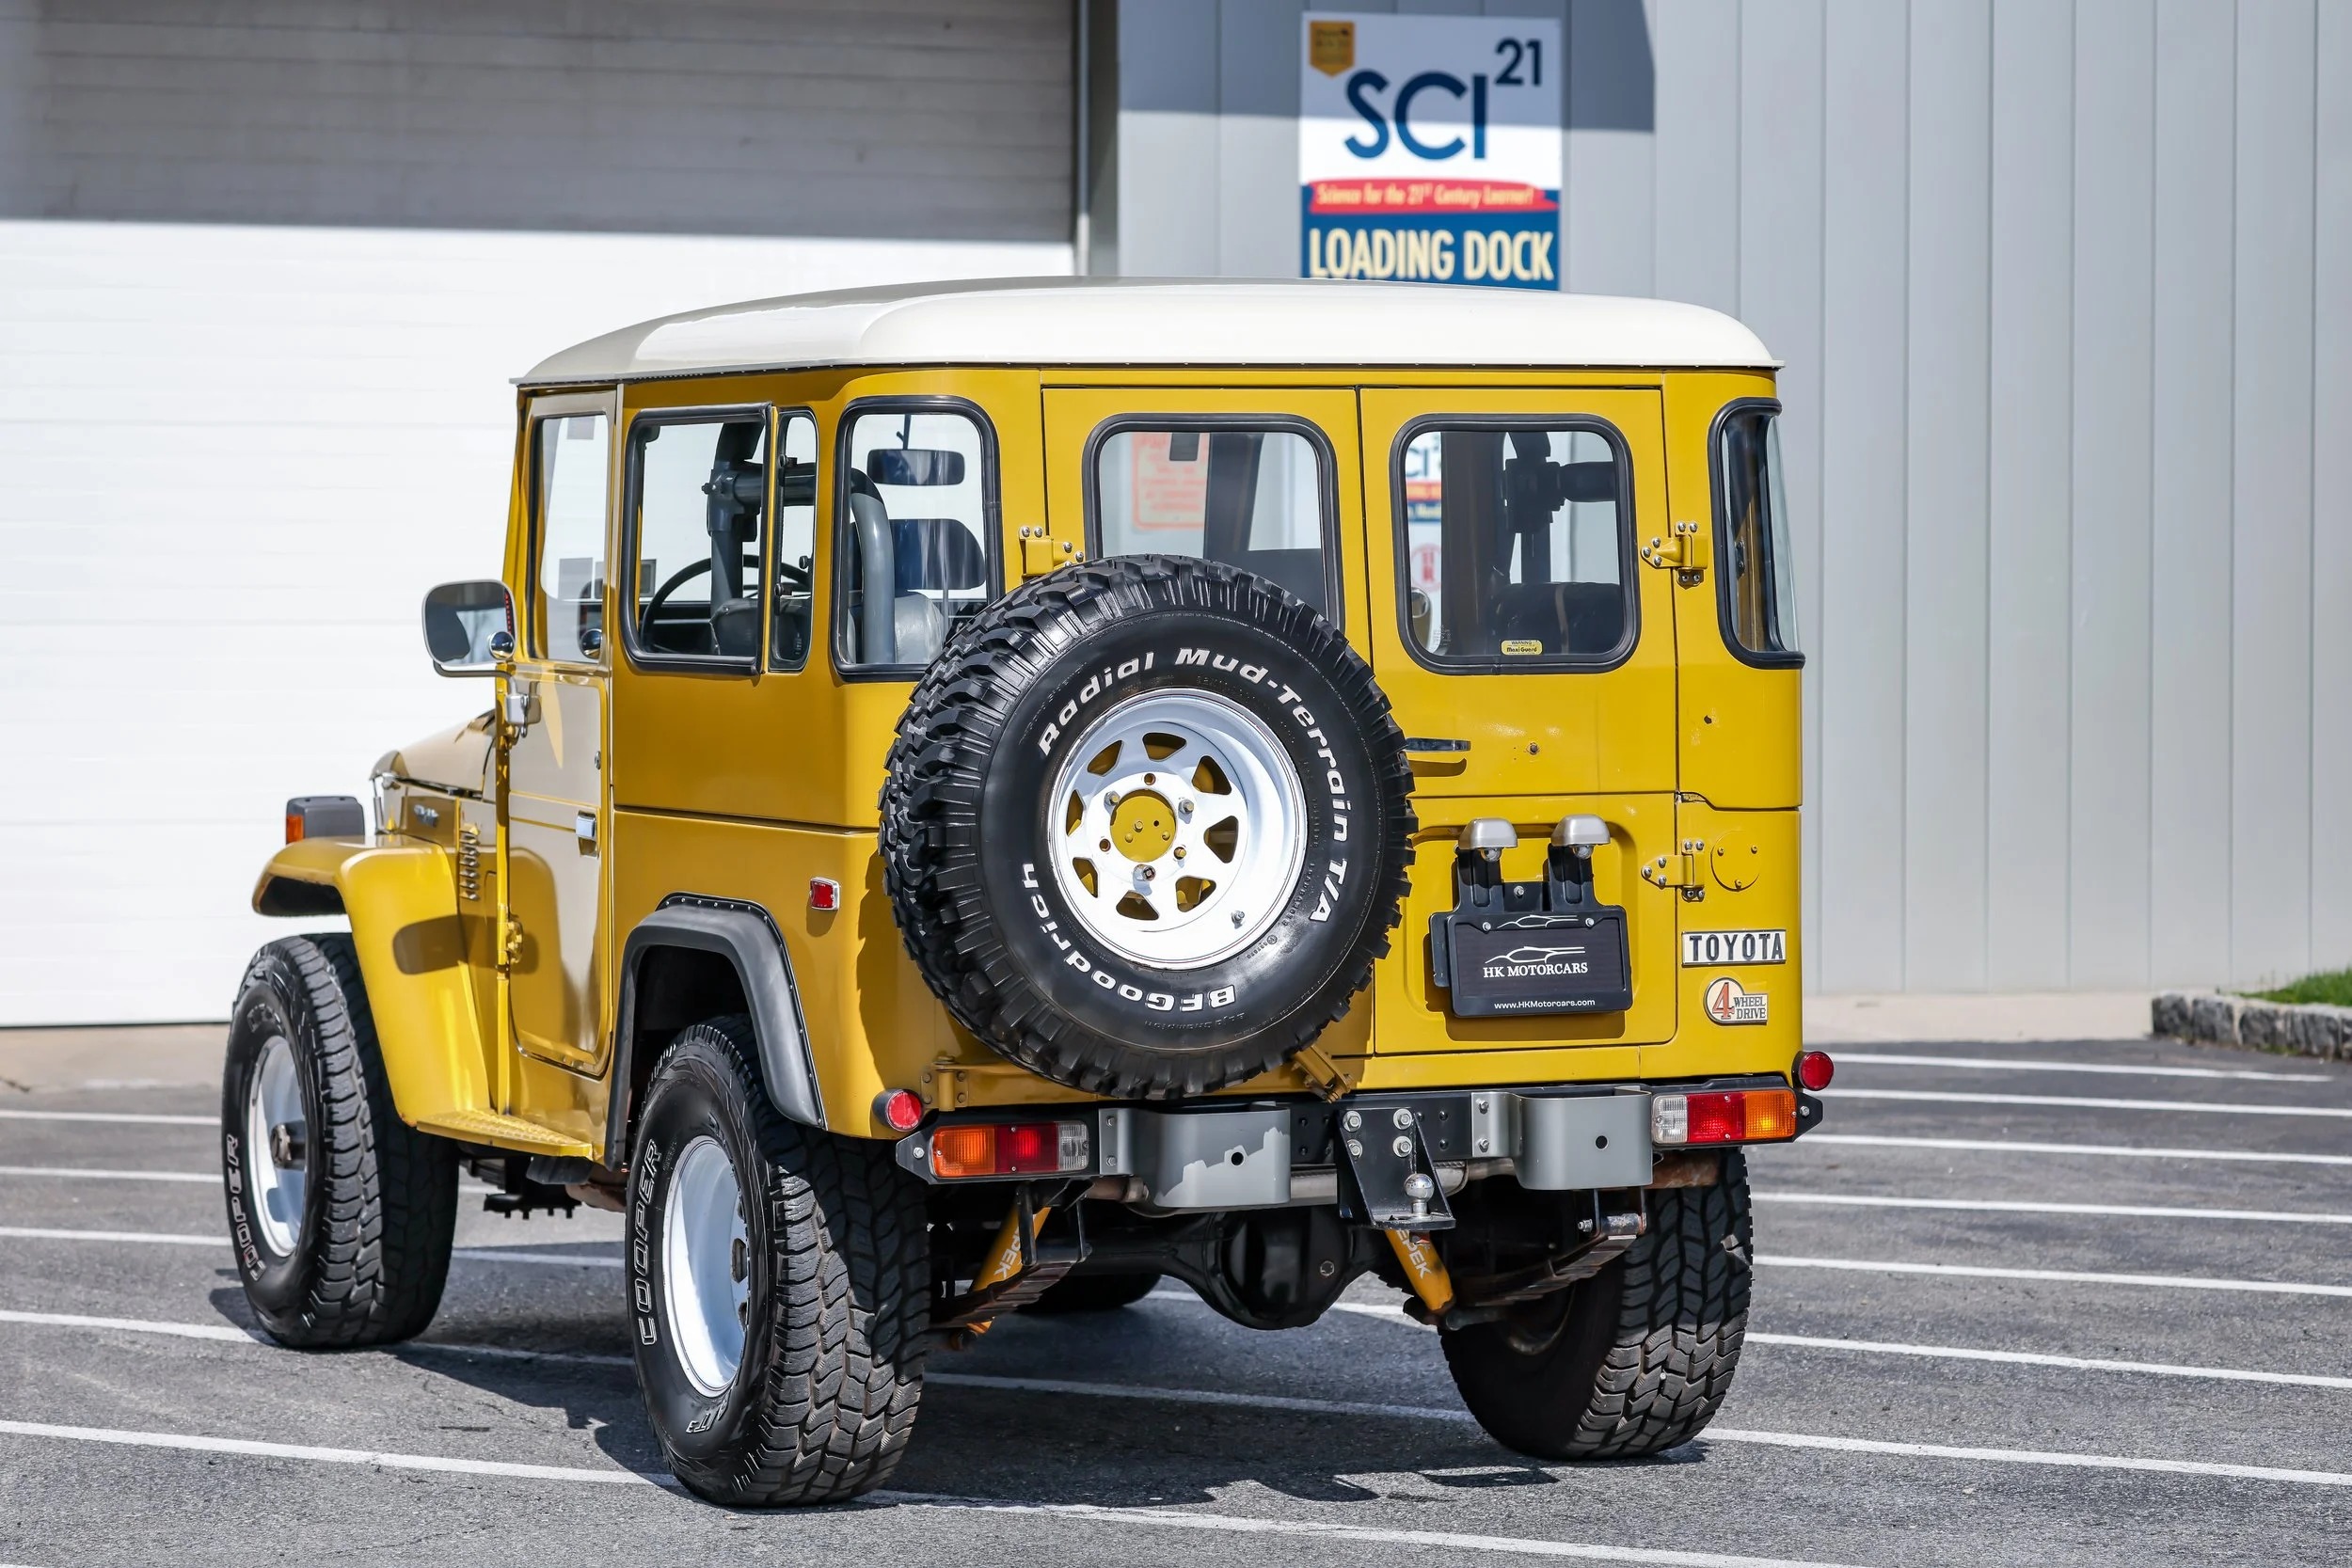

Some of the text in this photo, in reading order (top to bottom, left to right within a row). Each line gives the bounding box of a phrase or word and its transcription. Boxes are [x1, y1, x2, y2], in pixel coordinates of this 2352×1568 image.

[1344, 37, 1542, 160] SCI 21
[1317, 183, 1362, 205] Science
[1364, 182, 1383, 205] for
[1384, 182, 1406, 205] the
[1434, 183, 1481, 209] Century
[1309, 228, 1554, 280] LOADING DOCK
[1037, 651, 1154, 756] Radial
[1175, 647, 1352, 842] Mud-Terrain
[1309, 857, 1349, 923] T/A
[1022, 863, 1236, 1013] BFGoodrich
[1689, 933, 1784, 961] TOYOTA
[1483, 962, 1588, 978] HK MOTORCARS
[1494, 999, 1596, 1009] www.HKMotorcars.com
[1712, 982, 1766, 1020] 4 WHEEL
[1737, 1007, 1766, 1019] DRIVE
[227, 1133, 266, 1282] COOPER
[633, 1138, 662, 1346] COOPER
